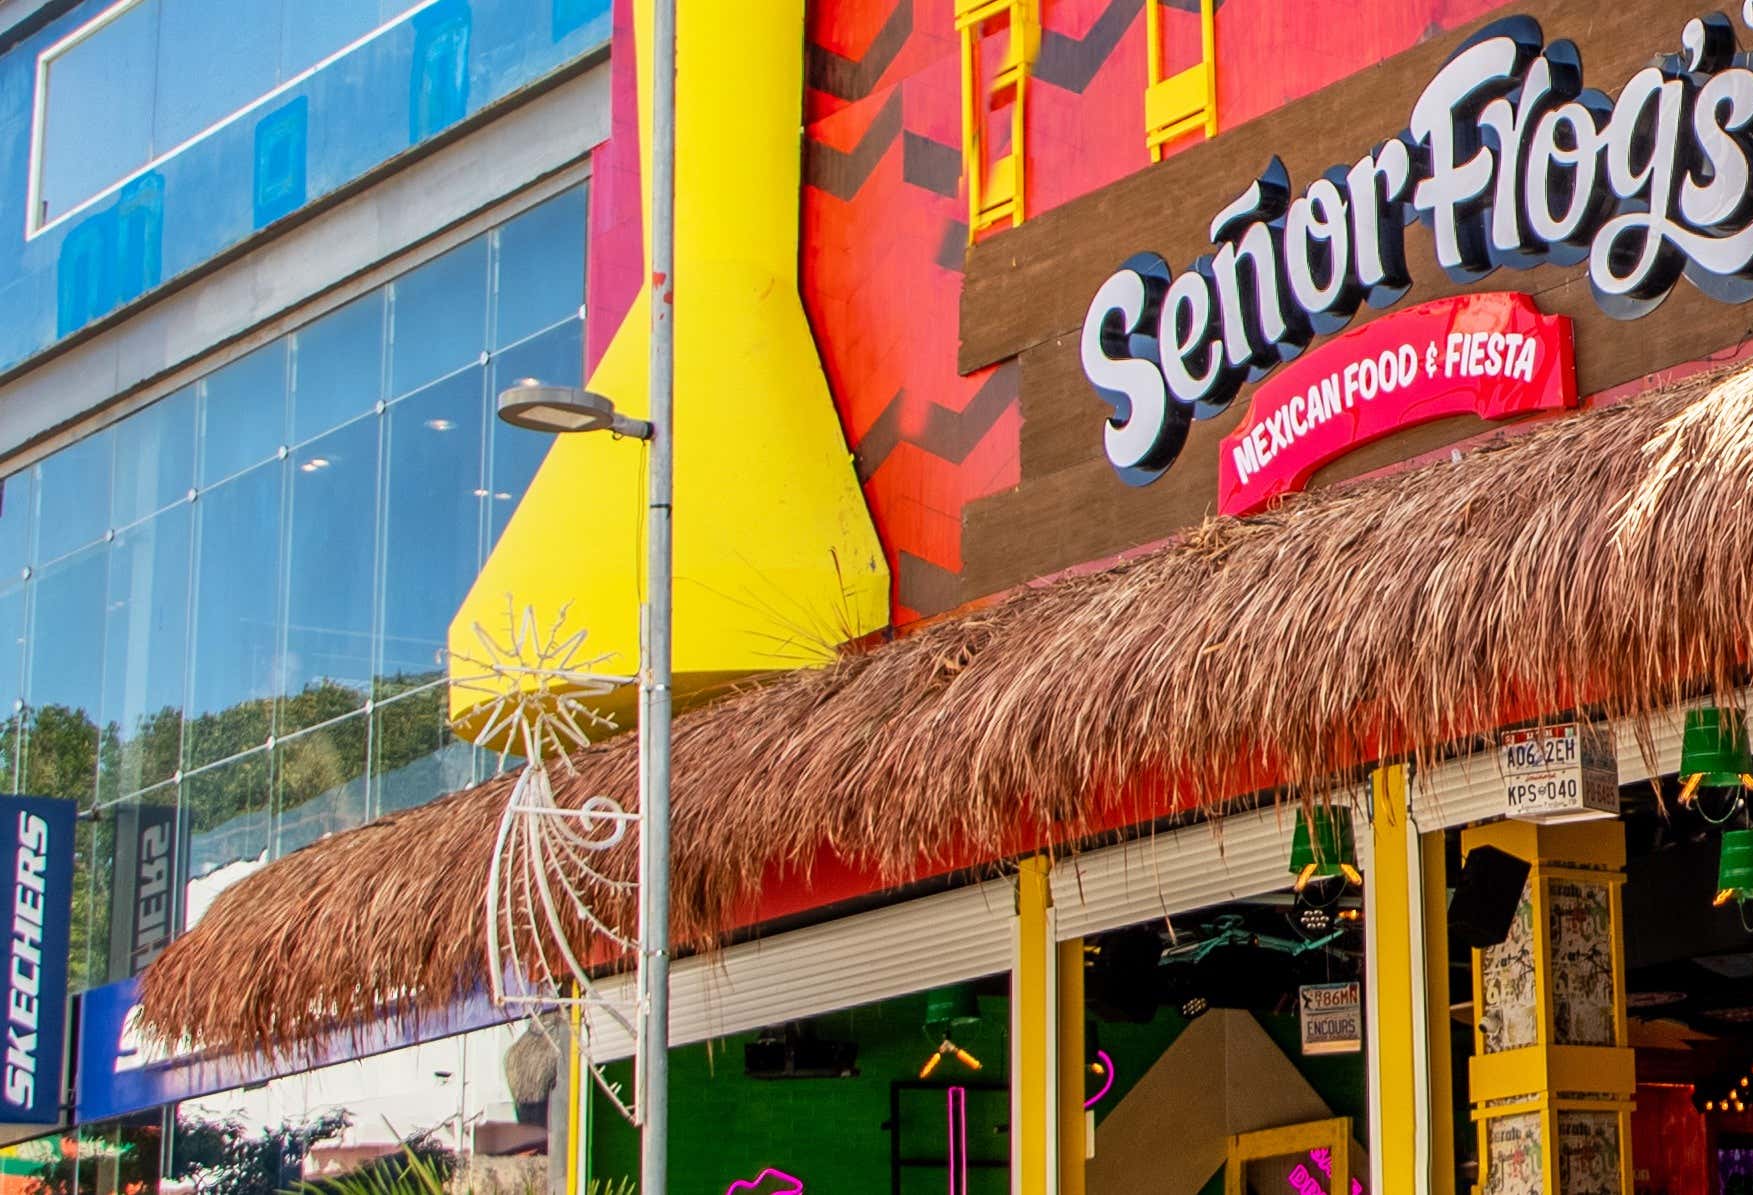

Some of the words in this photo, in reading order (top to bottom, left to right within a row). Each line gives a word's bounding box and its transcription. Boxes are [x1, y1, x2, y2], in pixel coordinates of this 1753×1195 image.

[1080, 138, 1411, 469] Señor
[1232, 371, 1342, 484] MEXICAN
[1343, 343, 1419, 408] FOOD
[1425, 340, 1440, 378] &
[1444, 332, 1537, 383] FIESTA
[1507, 784, 1537, 806] KPS
[5, 810, 49, 1111] SKECHERS
